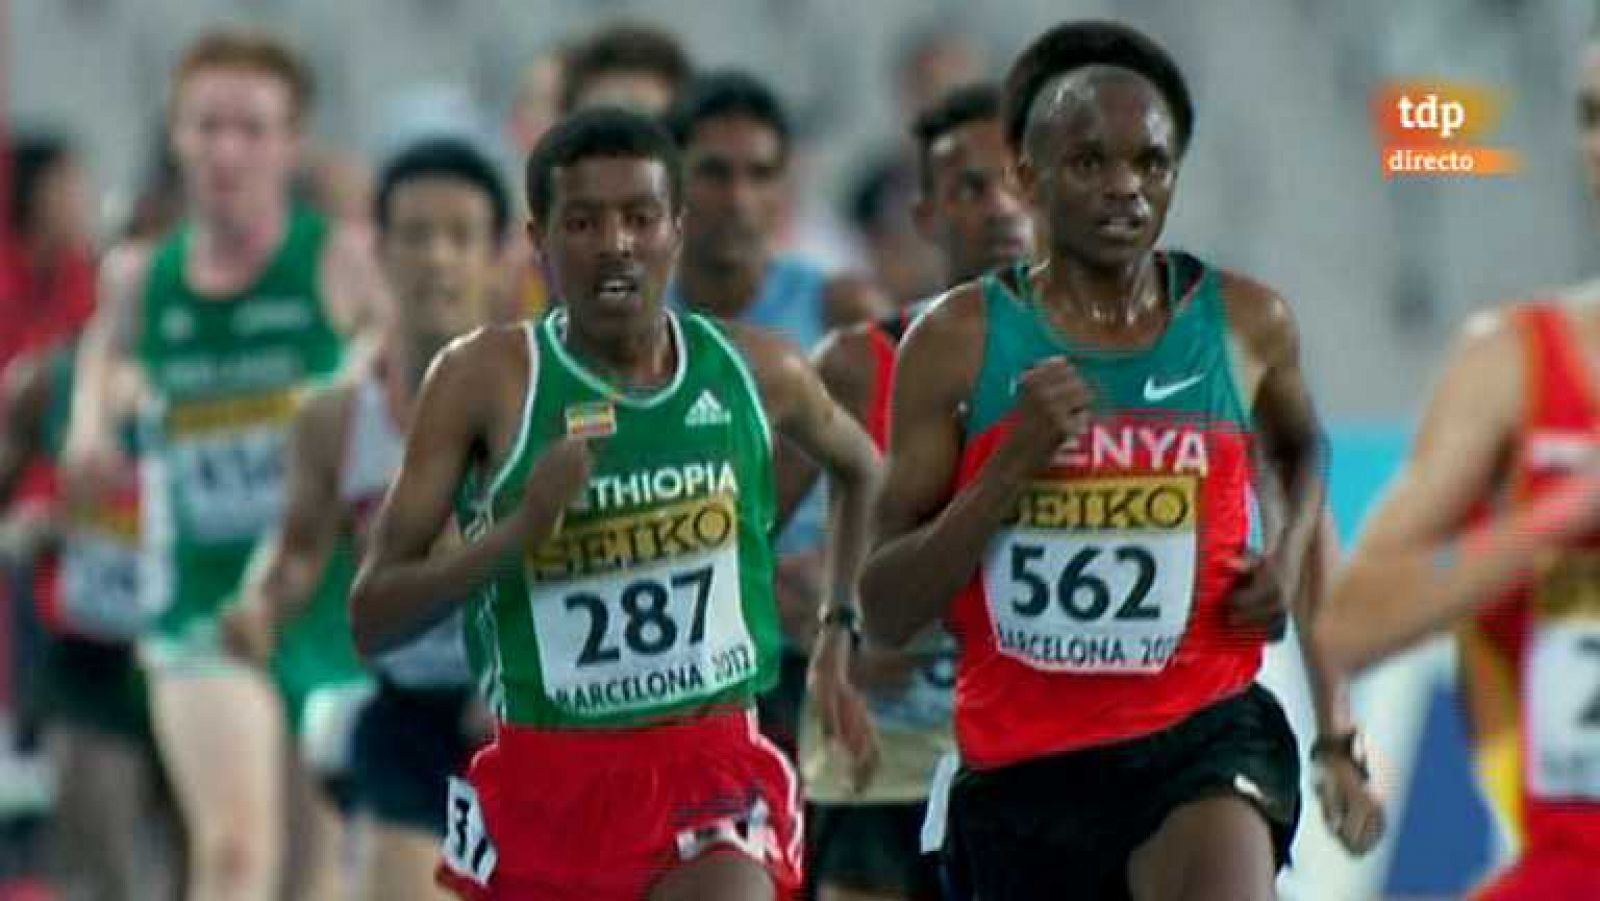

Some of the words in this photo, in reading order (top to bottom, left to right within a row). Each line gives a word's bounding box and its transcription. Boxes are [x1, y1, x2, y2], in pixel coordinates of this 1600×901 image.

[1051, 423, 1209, 478] ENYA
[586, 461, 739, 510] THIOPIA
[1005, 485, 1189, 530] EIKO
[1010, 544, 1162, 622] 562
[565, 565, 714, 668] 287
[997, 625, 1127, 668] ARCELONA
